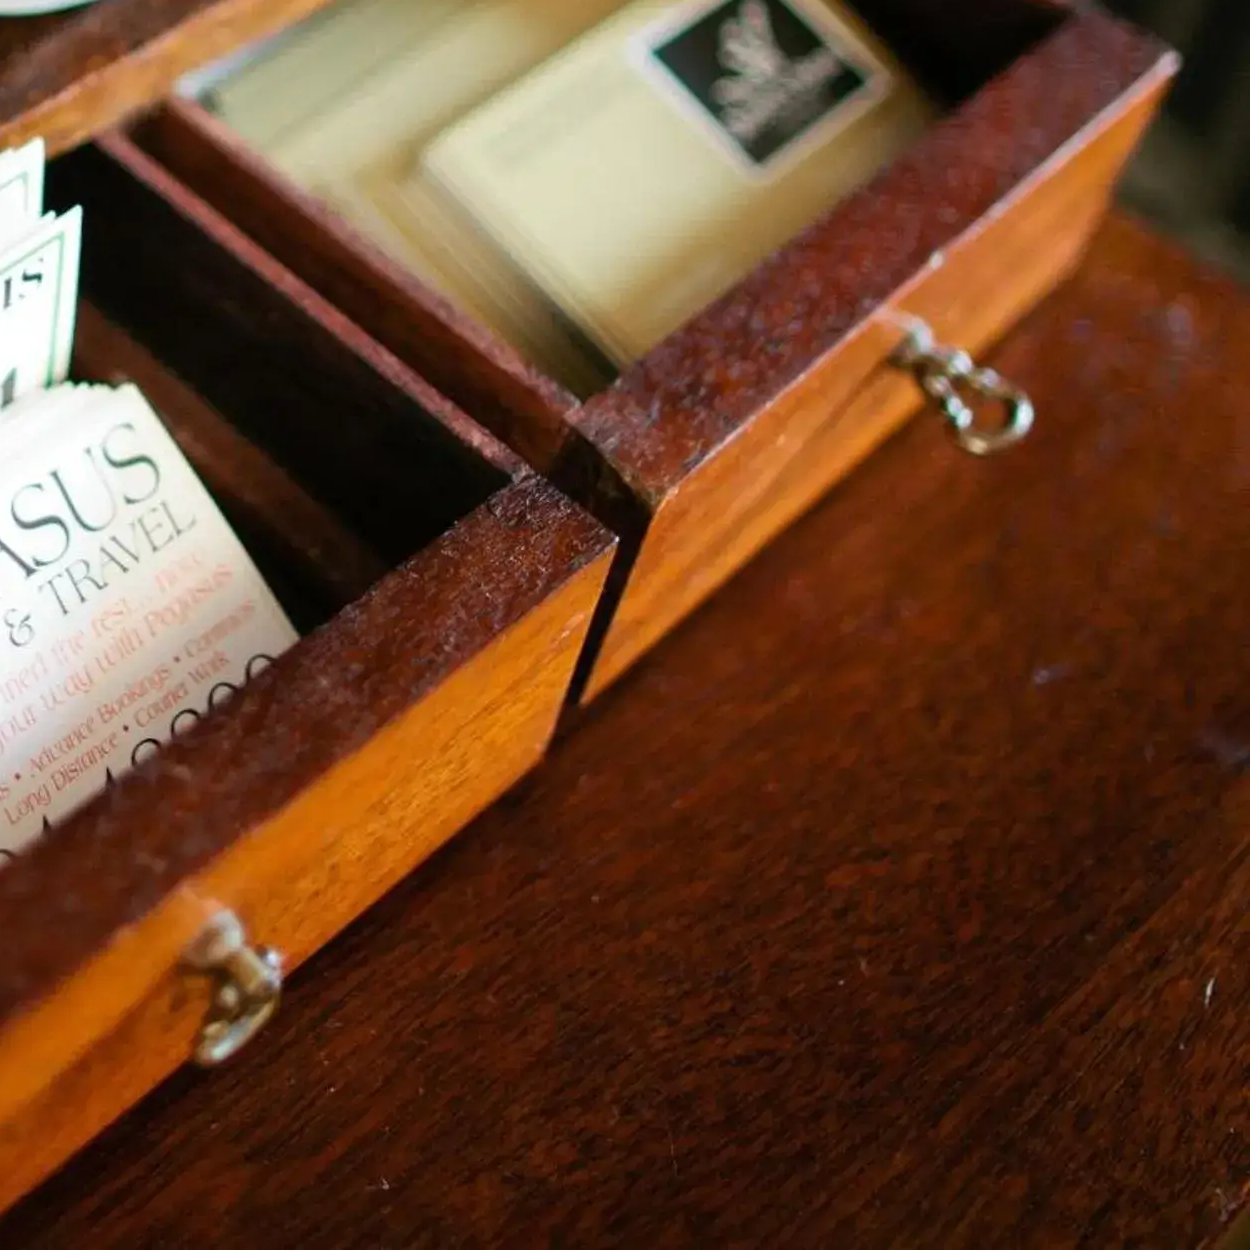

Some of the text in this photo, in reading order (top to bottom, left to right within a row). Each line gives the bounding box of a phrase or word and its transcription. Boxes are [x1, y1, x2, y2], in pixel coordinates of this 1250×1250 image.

[4, 607, 37, 648] &
[37, 500, 198, 616] TRAVEL
[29, 716, 95, 774] Advance
[97, 662, 170, 724] Bookings
[40, 661, 93, 712] way
[95, 626, 144, 675] with
[3, 783, 52, 826] Long
[51, 731, 119, 792] Distance
